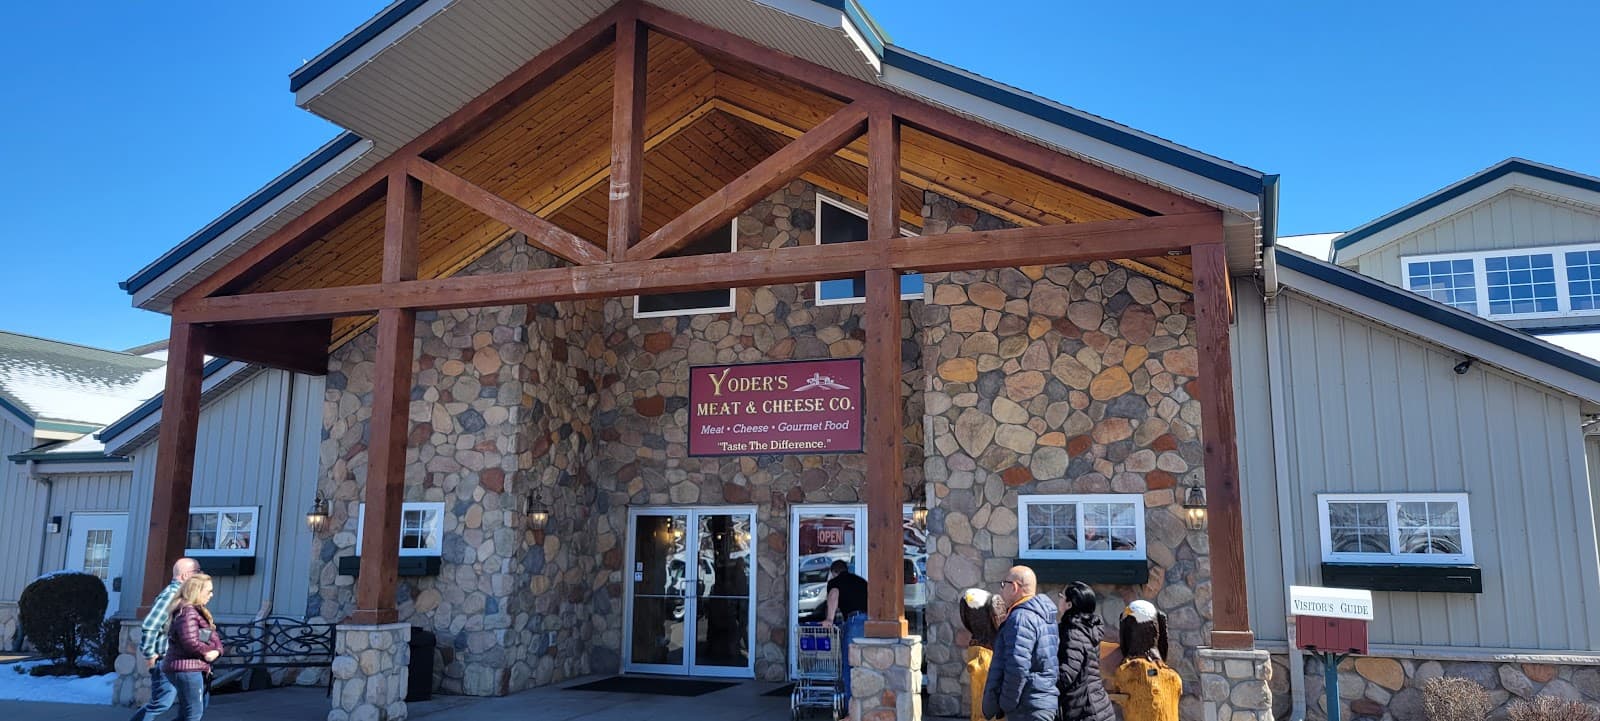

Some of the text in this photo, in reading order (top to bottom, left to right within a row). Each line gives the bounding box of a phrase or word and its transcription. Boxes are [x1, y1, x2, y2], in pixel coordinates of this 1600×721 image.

[708, 368, 789, 396] YODER'S
[697, 397, 855, 416] MEAT & CHEESE CO.
[701, 420, 850, 435] Meat Cheese Gourmet Food
[717, 441, 748, 451] "Taste
[749, 441, 768, 450] The
[819, 531, 842, 543] OPEN
[1294, 599, 1369, 615] VISITOR'S GUIDE
